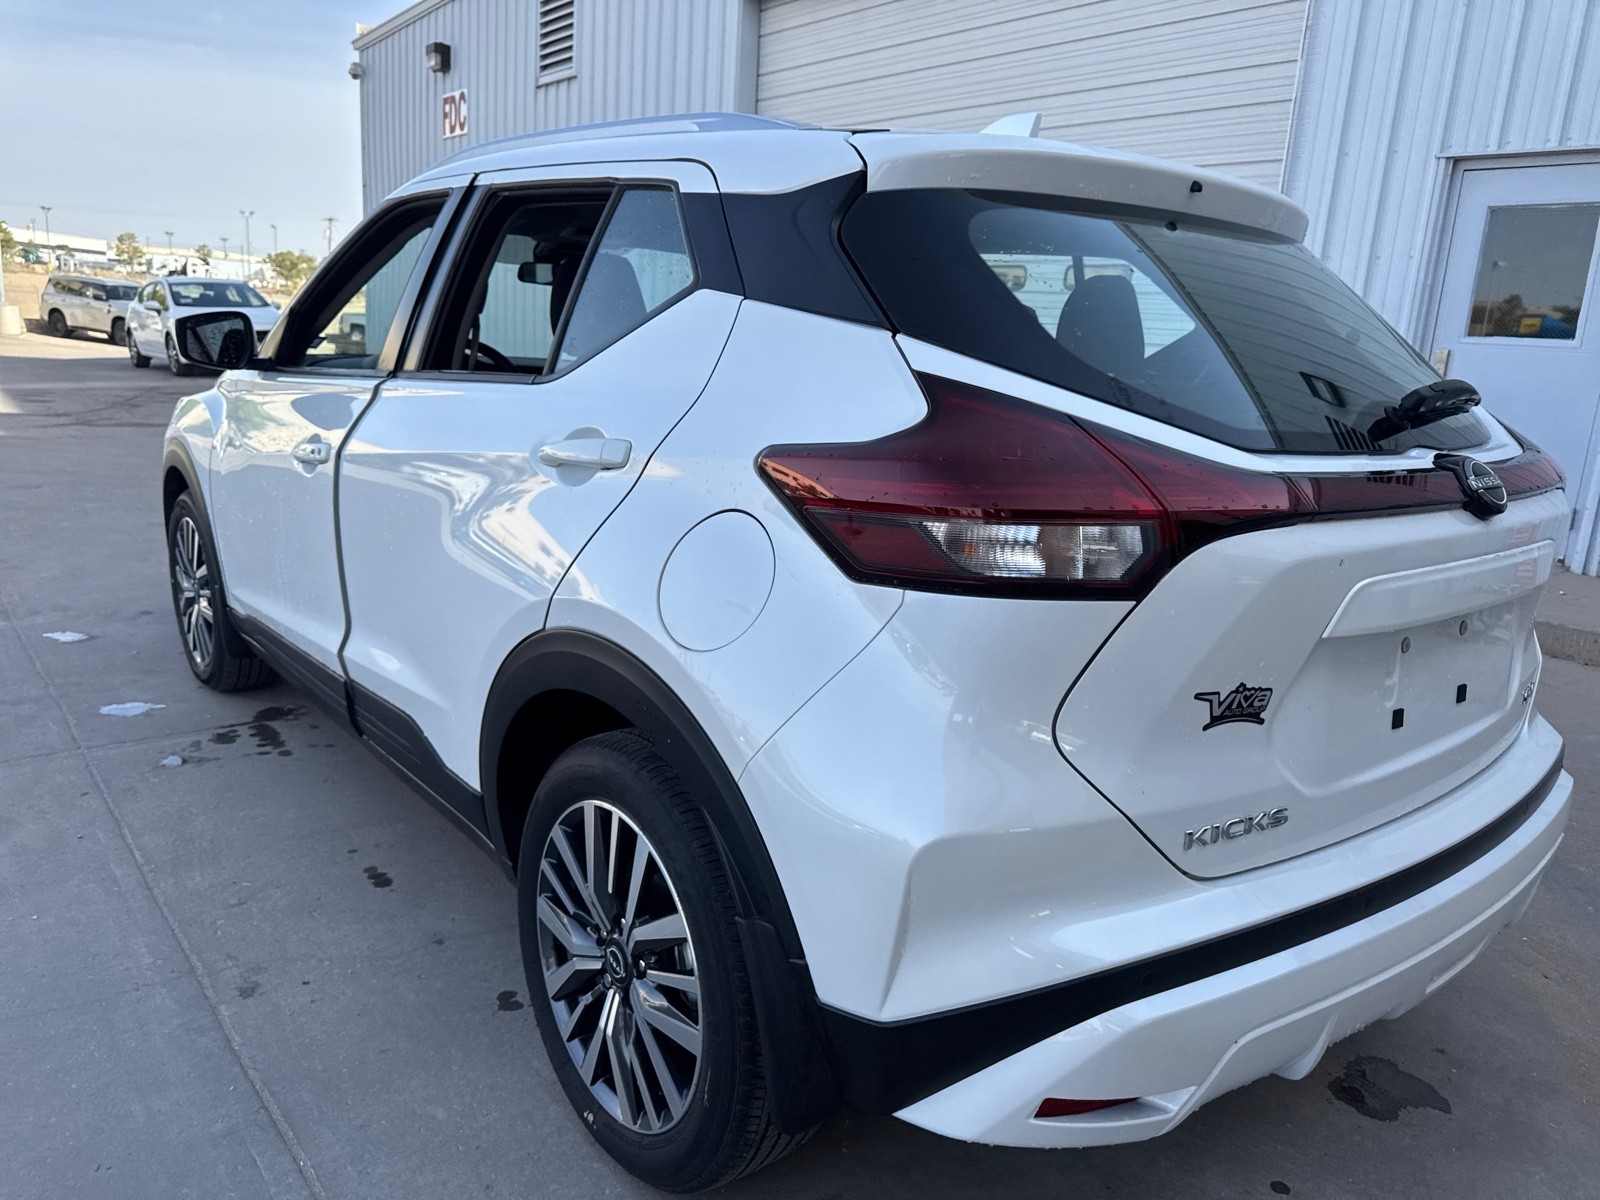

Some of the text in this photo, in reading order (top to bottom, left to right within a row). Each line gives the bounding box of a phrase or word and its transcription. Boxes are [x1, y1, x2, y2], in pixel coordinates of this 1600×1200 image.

[443, 91, 467, 136] FDC
[1471, 476, 1500, 488] NISS
[1223, 705, 1266, 716] AUTO GROUP
[1183, 806, 1288, 851] KICKS
